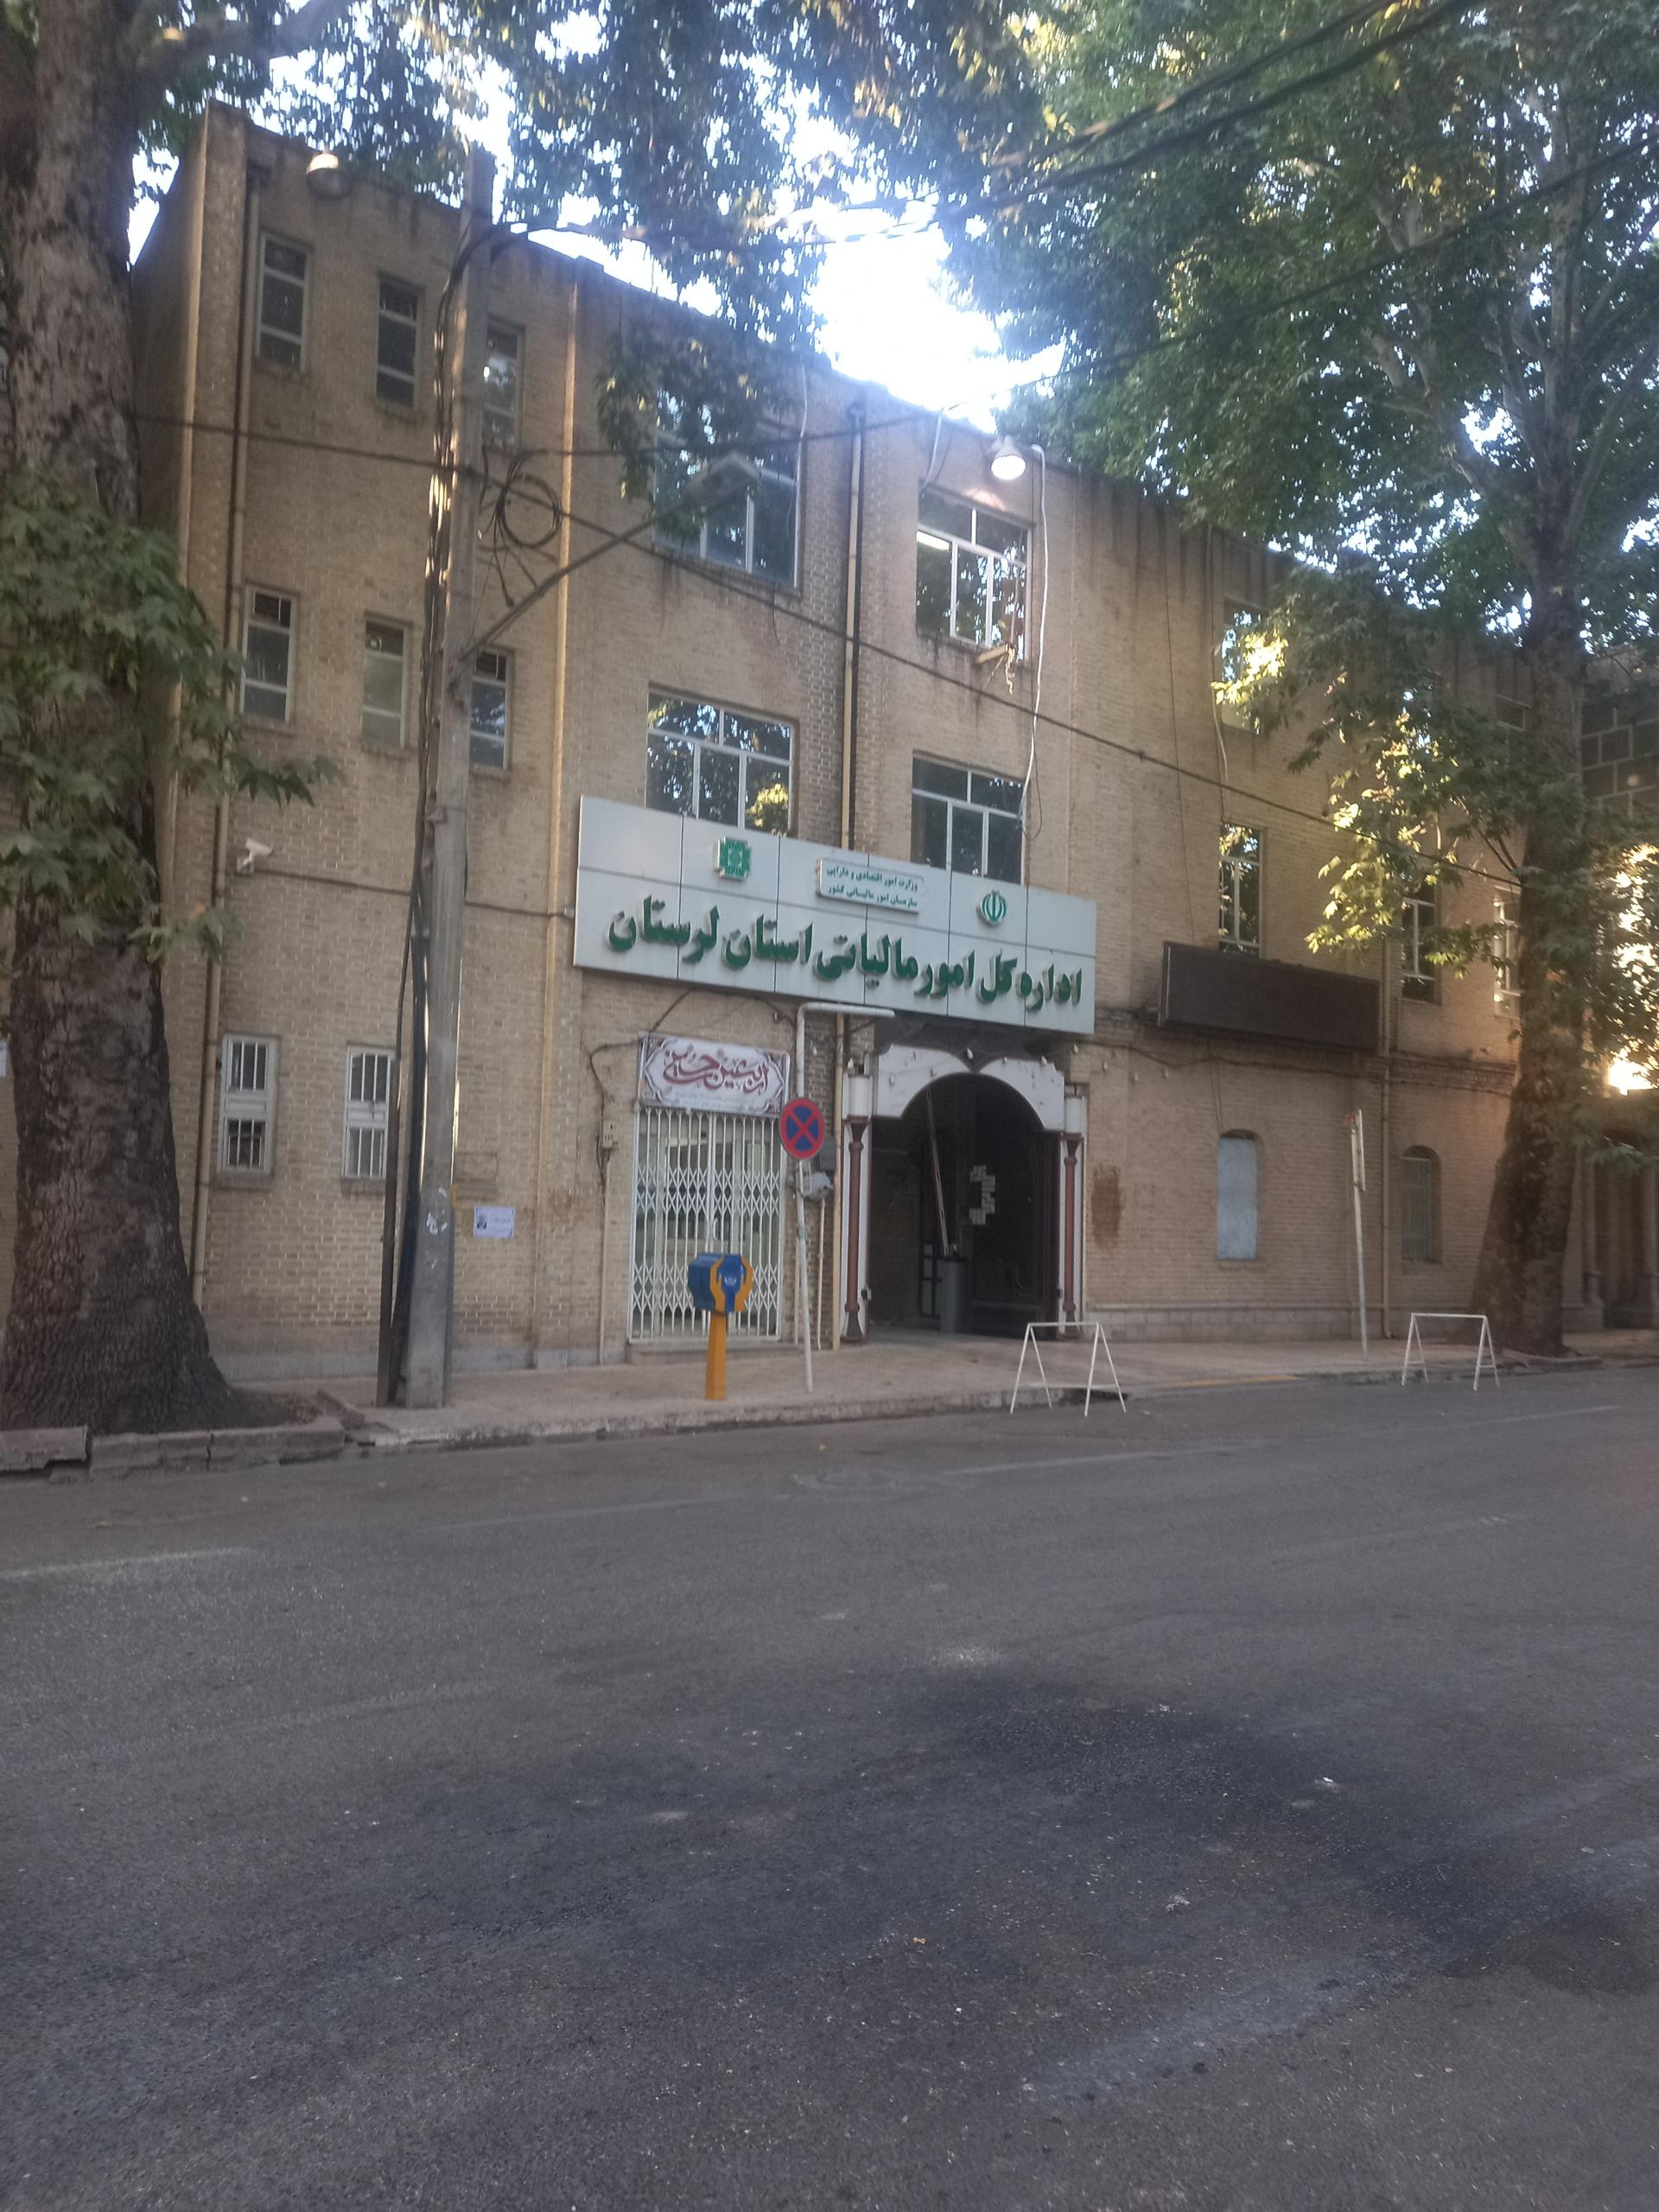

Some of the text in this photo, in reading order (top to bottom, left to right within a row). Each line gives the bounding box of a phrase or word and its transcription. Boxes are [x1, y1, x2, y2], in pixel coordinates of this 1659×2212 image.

[884, 876, 898, 887] امور
[898, 879, 918, 892] وزارت
[829, 883, 918, 907] سازمان امور مالیاتی کشور
[607, 893, 1083, 1012] اداره کل امور مالیاتی استان لرستان
[702, 1058, 771, 1095] اربعین
